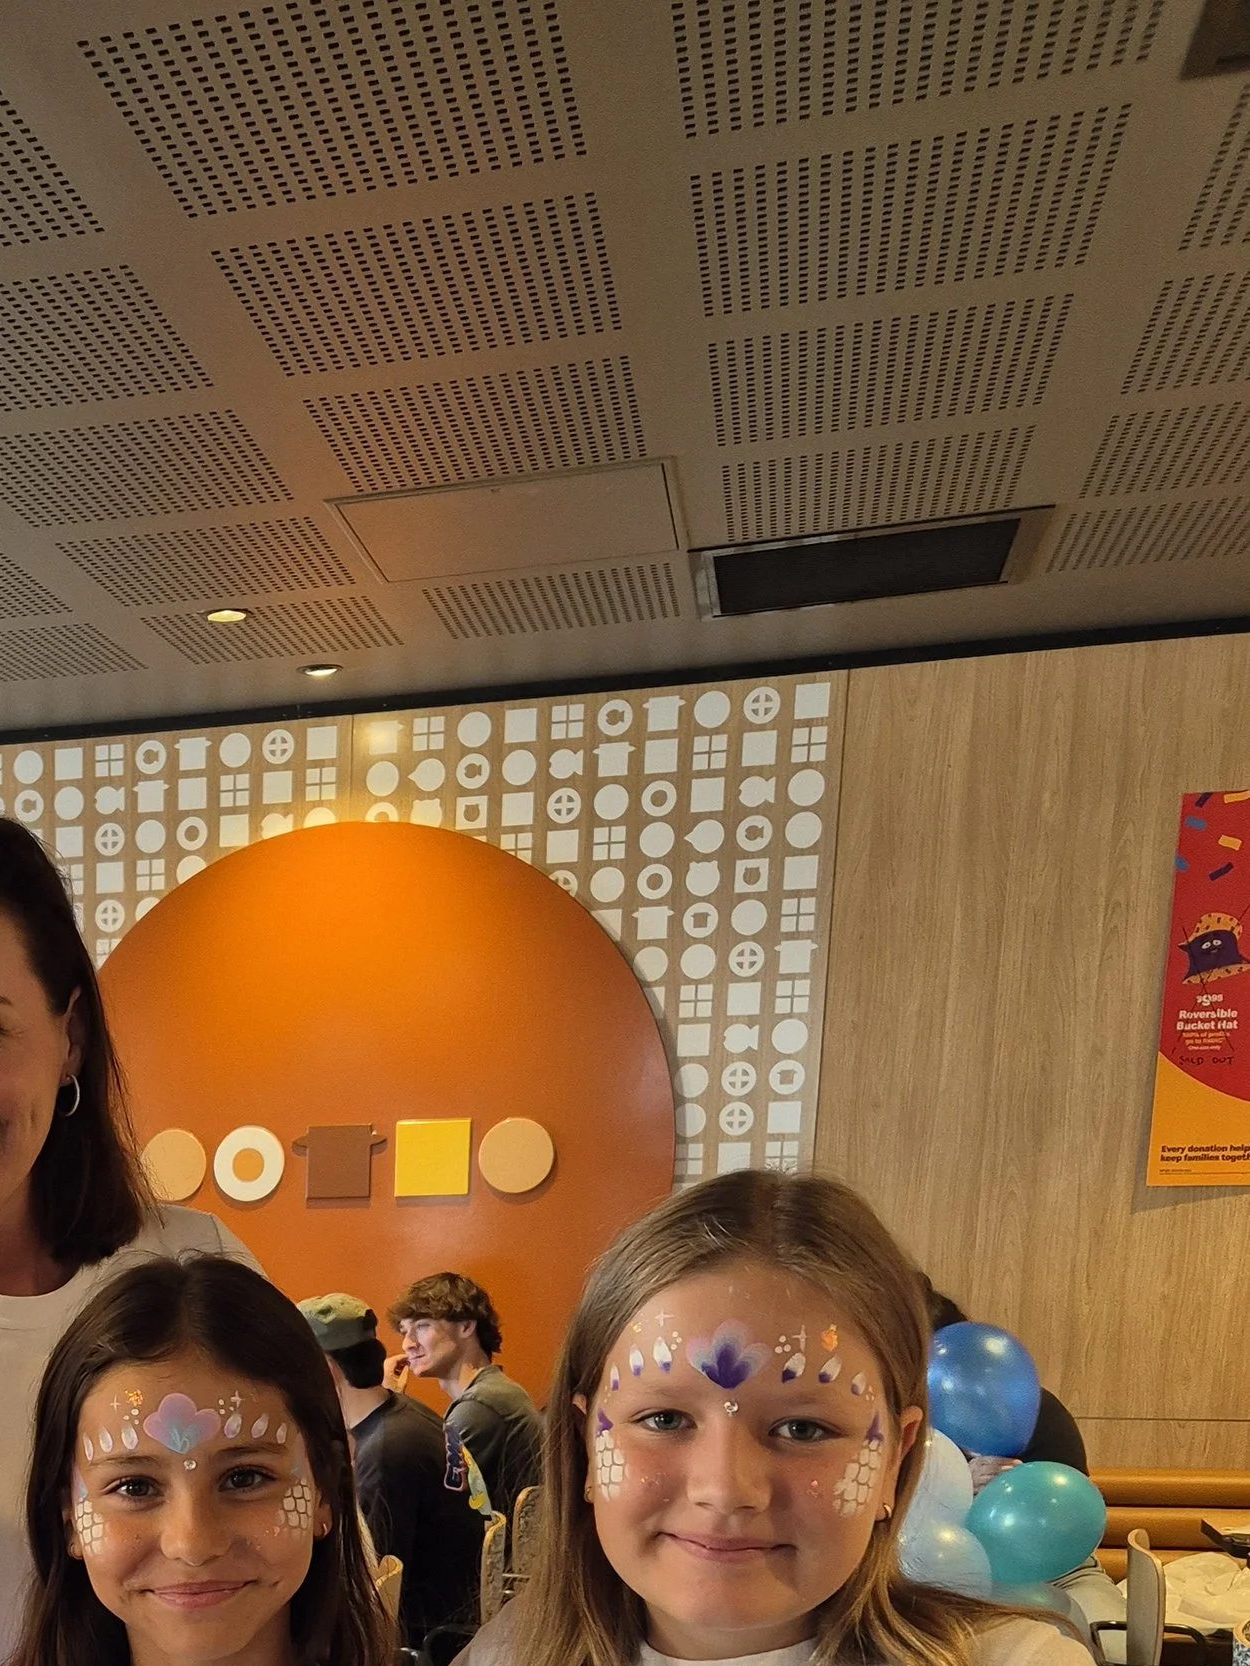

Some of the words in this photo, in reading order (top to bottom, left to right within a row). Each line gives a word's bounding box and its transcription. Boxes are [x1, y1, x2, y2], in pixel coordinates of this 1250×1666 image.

[1179, 1008, 1238, 1019] Reversible
[1176, 1020, 1215, 1031] Bucket
[1217, 1019, 1238, 1030] Hat
[1161, 1145, 1186, 1154] Every
[1188, 1144, 1228, 1153] donation
[1160, 1154, 1182, 1163] keep
[1184, 1154, 1219, 1162] families
